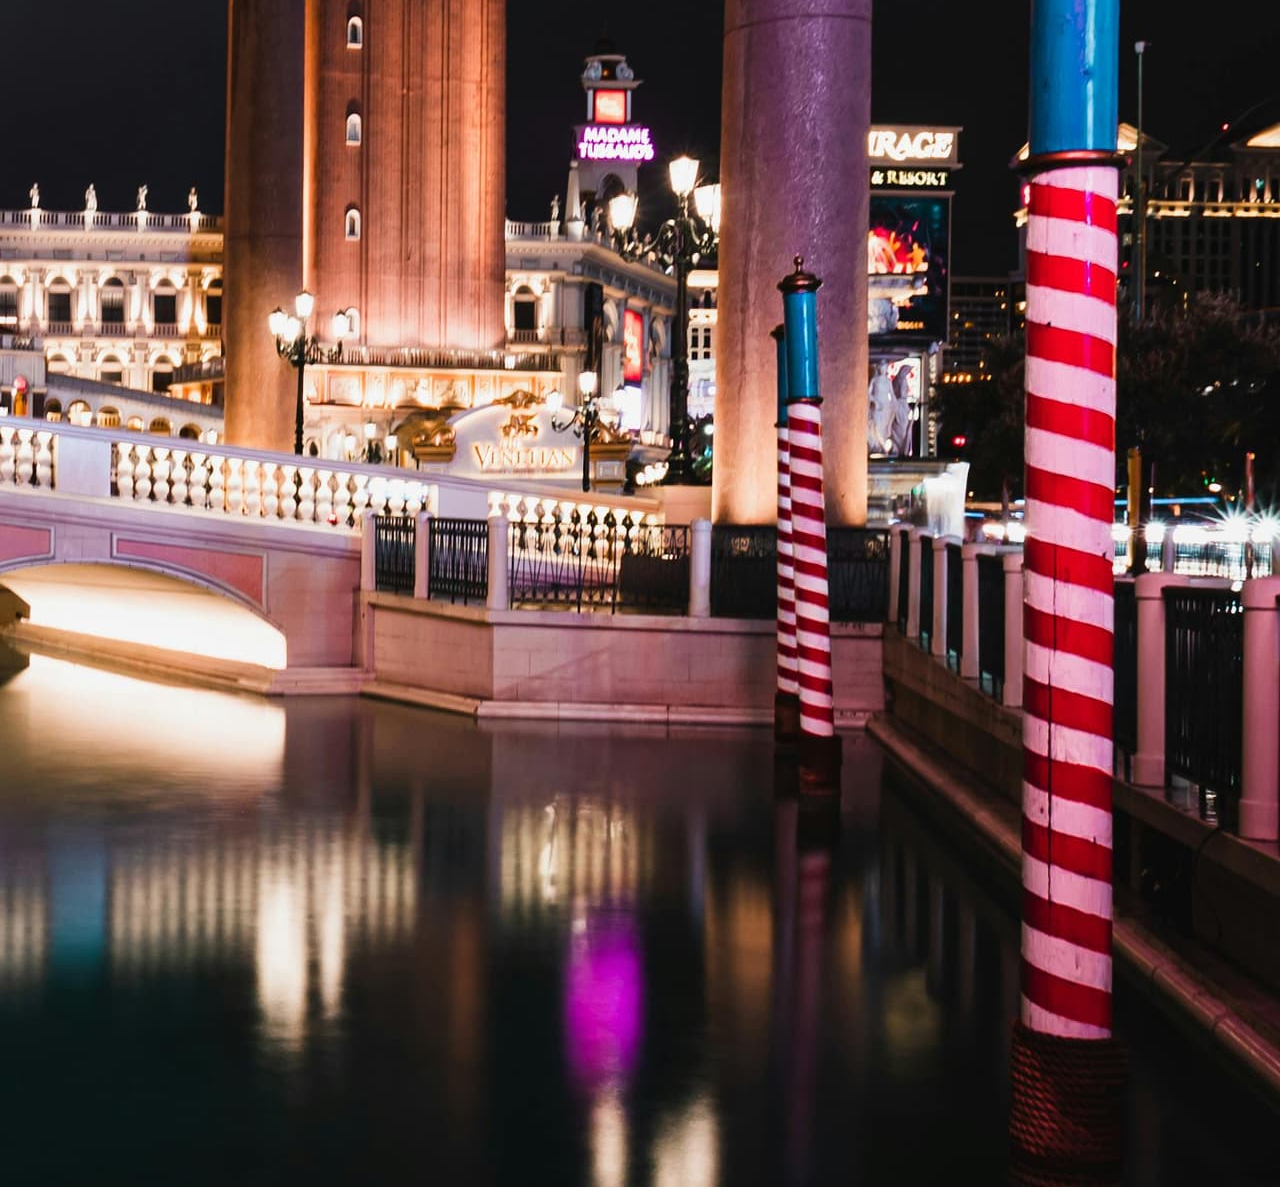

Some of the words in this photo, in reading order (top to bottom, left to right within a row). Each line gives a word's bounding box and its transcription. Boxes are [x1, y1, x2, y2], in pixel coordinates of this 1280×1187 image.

[583, 127, 651, 144] MADAME
[578, 142, 655, 160] TUSSAUDS
[871, 171, 884, 185] &
[887, 170, 948, 186] RESORT
[472, 444, 577, 469] VENETIAN
